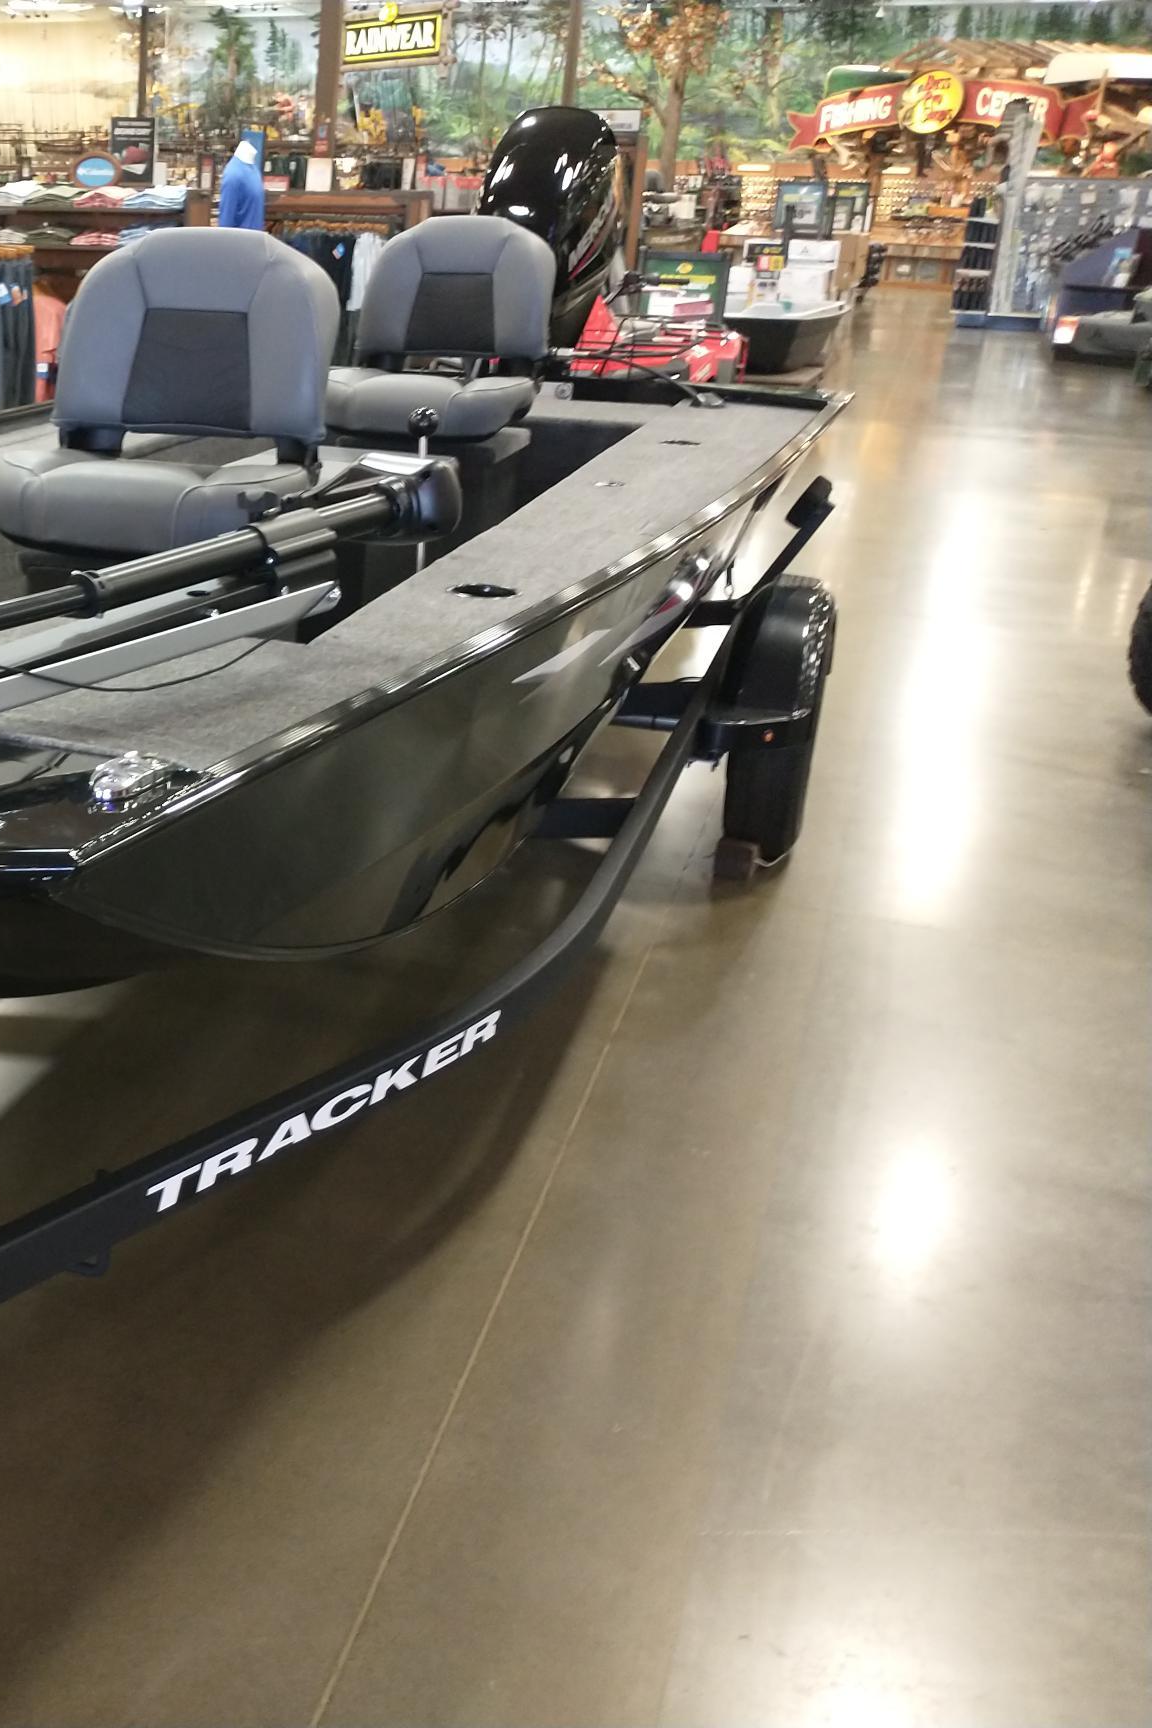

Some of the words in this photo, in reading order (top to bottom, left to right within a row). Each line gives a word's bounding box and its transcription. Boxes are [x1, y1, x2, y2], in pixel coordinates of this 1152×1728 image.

[345, 20, 435, 56] RAINWEAR
[819, 96, 892, 133] FISHING
[146, 1009, 502, 1213] TRACKER
